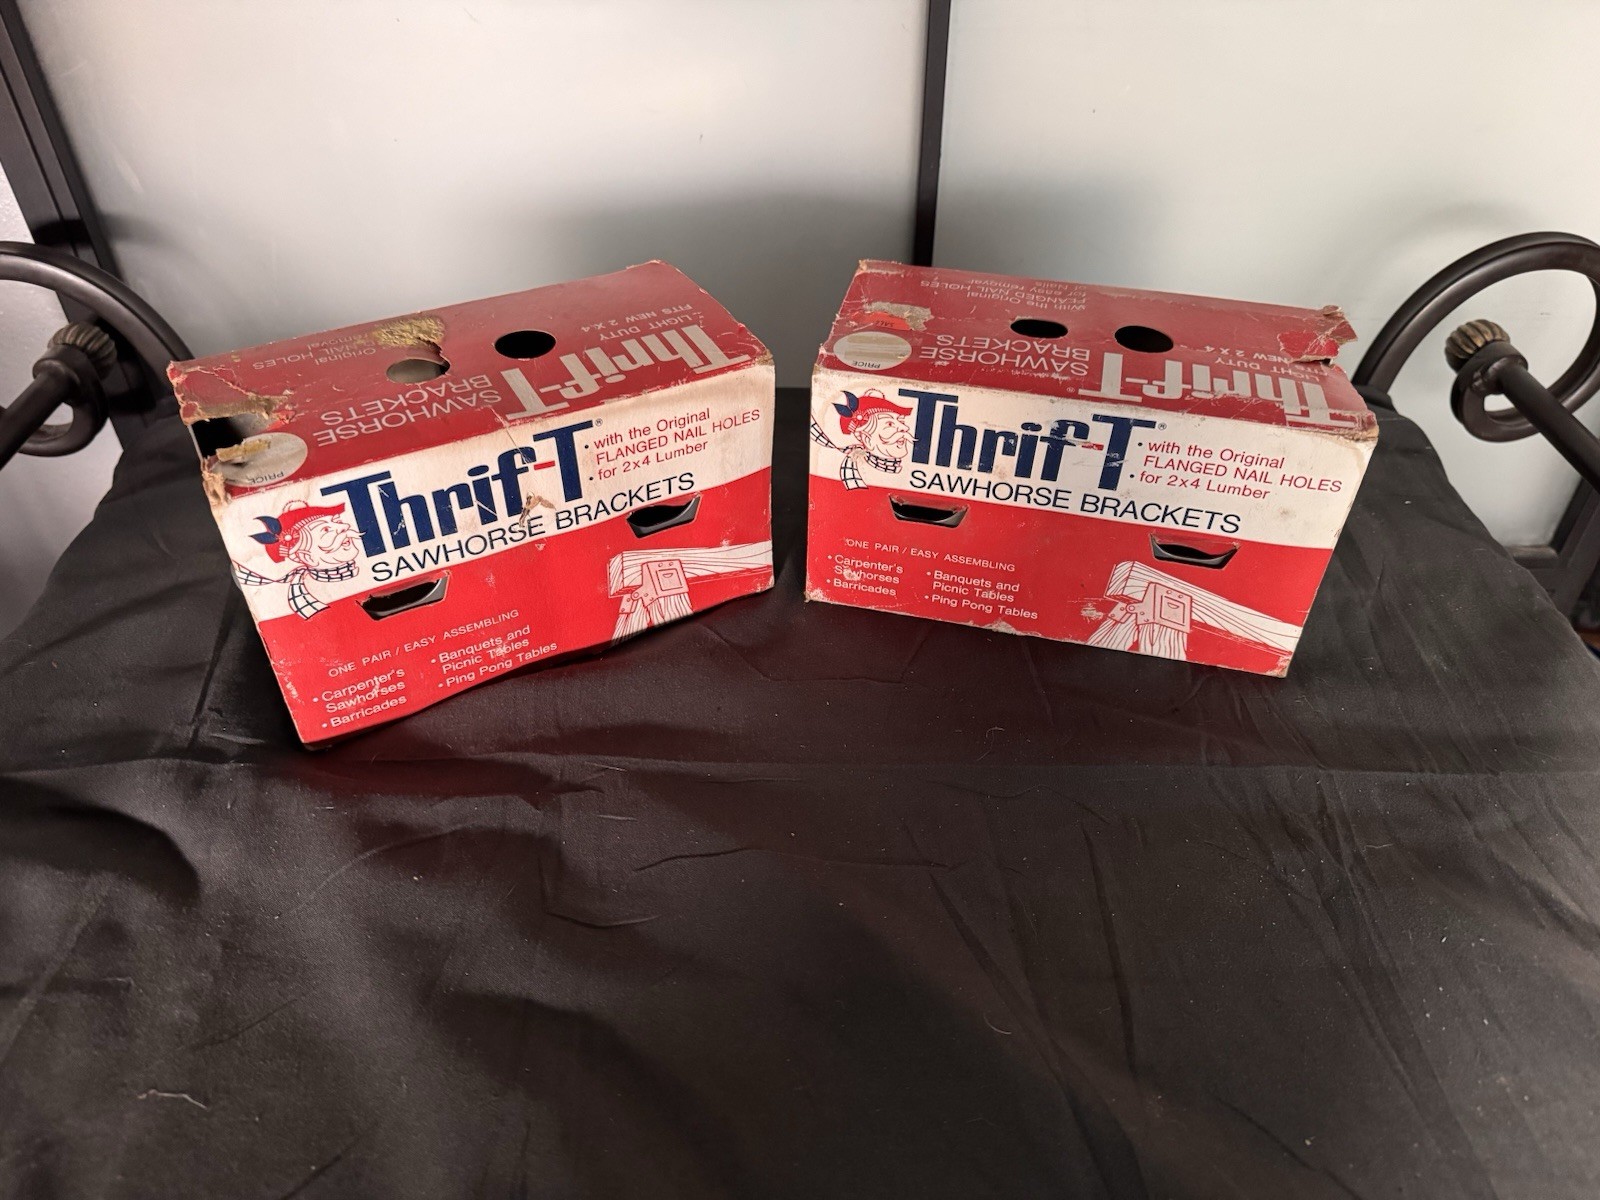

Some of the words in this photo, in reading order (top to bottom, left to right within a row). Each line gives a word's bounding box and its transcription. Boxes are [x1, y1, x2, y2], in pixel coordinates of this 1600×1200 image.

[920, 280, 971, 293] HOLES
[966, 291, 1021, 304] Original
[976, 286, 1009, 298] NAIL
[629, 311, 657, 323] NEW
[653, 313, 693, 331] LIGHT
[661, 303, 693, 315] FITS
[599, 324, 641, 341] DUTY
[252, 352, 314, 370] HOLES
[315, 348, 377, 366] Original
[919, 346, 1088, 376] SAWHORSE
[936, 334, 1091, 361] BRACKETS
[853, 360, 881, 369] PRICE
[1215, 357, 1260, 370] DUTY
[320, 374, 493, 426] BRACKETS
[312, 389, 501, 447] SAWHORSE
[594, 432, 623, 450] with
[628, 424, 651, 440] the
[656, 408, 711, 432] Original
[596, 435, 668, 465] FLANGED
[674, 426, 707, 445] NAIL
[712, 409, 761, 433] HOLES
[598, 468, 617, 481] for
[622, 458, 651, 473] 2x4
[656, 440, 709, 464] Lumber
[1148, 441, 1180, 455] with
[1187, 444, 1213, 459] the
[1220, 448, 1285, 469] Original
[1140, 470, 1162, 484] for
[1167, 476, 1201, 489] 2x4
[1206, 480, 1270, 500] Lumber
[1143, 456, 1227, 476] FLANGED
[1233, 467, 1273, 484] NAIL
[1280, 475, 1343, 493] HOLES
[909, 470, 1071, 509] SAWHORSE
[1080, 493, 1241, 533] BRACKETS
[371, 515, 546, 582] SAWHORSE
[556, 472, 695, 530] BRACKETS
[834, 554, 904, 574] Carpenter's
[846, 539, 870, 549] ONE
[874, 542, 900, 553] PAIR
[910, 548, 939, 559] EASY
[943, 553, 1015, 572] ASSEMBLING
[833, 578, 896, 596] Barricades
[932, 581, 969, 595] Picnic
[975, 588, 1015, 602] Tables
[934, 570, 992, 588] Banquets
[996, 581, 1020, 592] and
[932, 594, 958, 608] Ping
[962, 600, 993, 614] Pong
[997, 605, 1038, 620] Tables
[328, 663, 357, 678] ONE
[362, 649, 392, 667] PAIR
[404, 636, 437, 653] EASY
[443, 609, 519, 639] ASSEMBLING
[439, 637, 503, 664] Banquets
[507, 625, 531, 642] and
[442, 655, 482, 675] Picnic
[488, 638, 530, 660] Tables
[446, 672, 476, 690] Ping
[480, 658, 513, 677] Pong
[518, 641, 558, 662] Tables
[321, 668, 406, 702] Carpenter's
[325, 681, 406, 713] Sawhorses
[330, 695, 407, 728] Barricades
